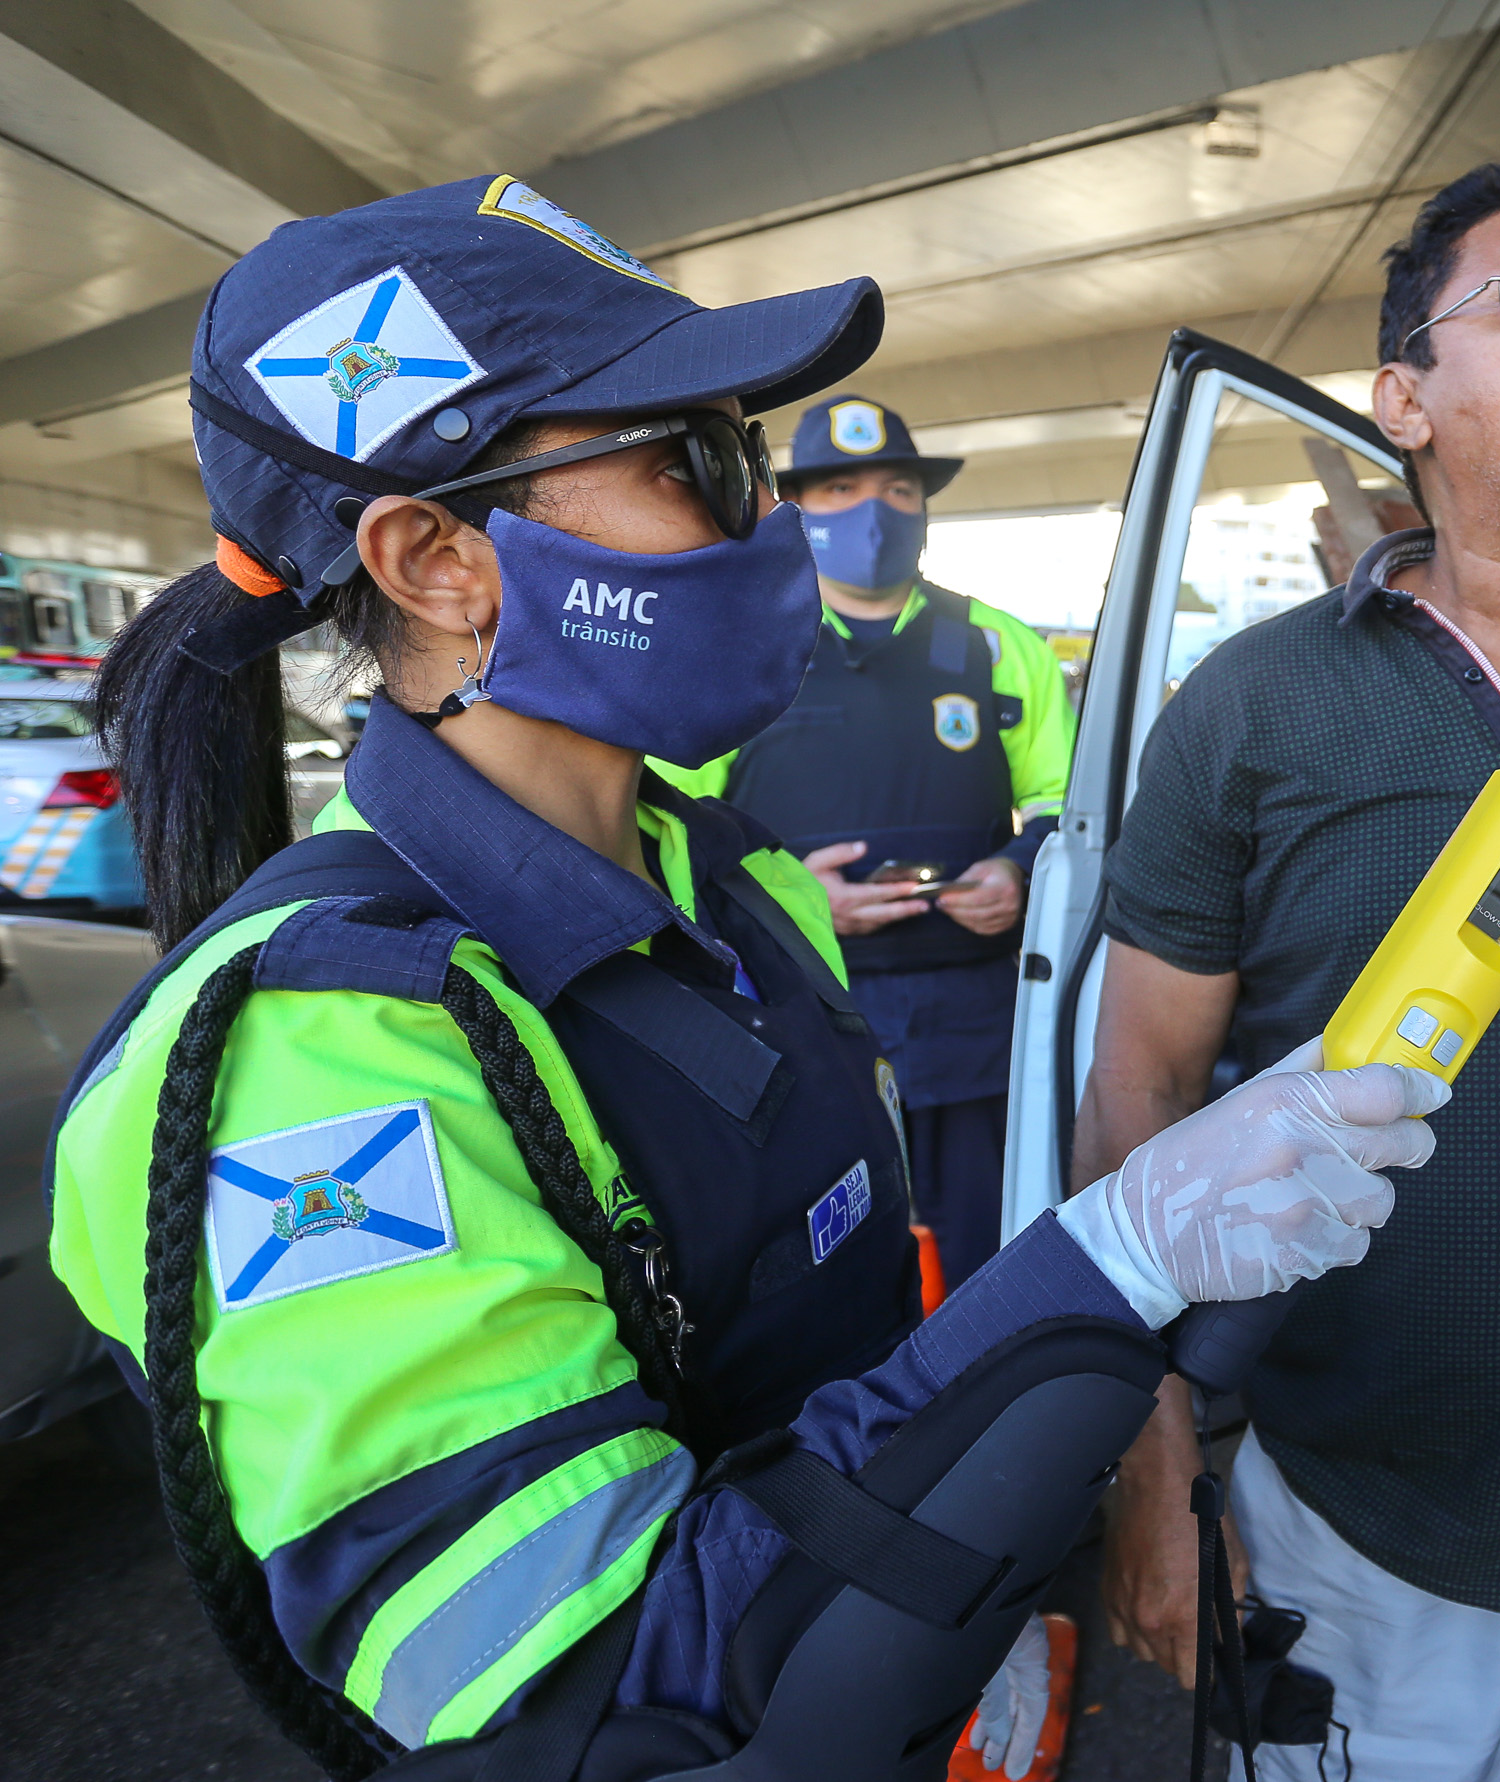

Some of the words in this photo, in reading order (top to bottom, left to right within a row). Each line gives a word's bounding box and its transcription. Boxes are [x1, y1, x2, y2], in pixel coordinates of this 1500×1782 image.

[562, 578, 659, 625] AMC
[561, 619, 650, 651] trânsito
[845, 1167, 863, 1194] SEJA
[849, 1183, 868, 1210] LEGAL
